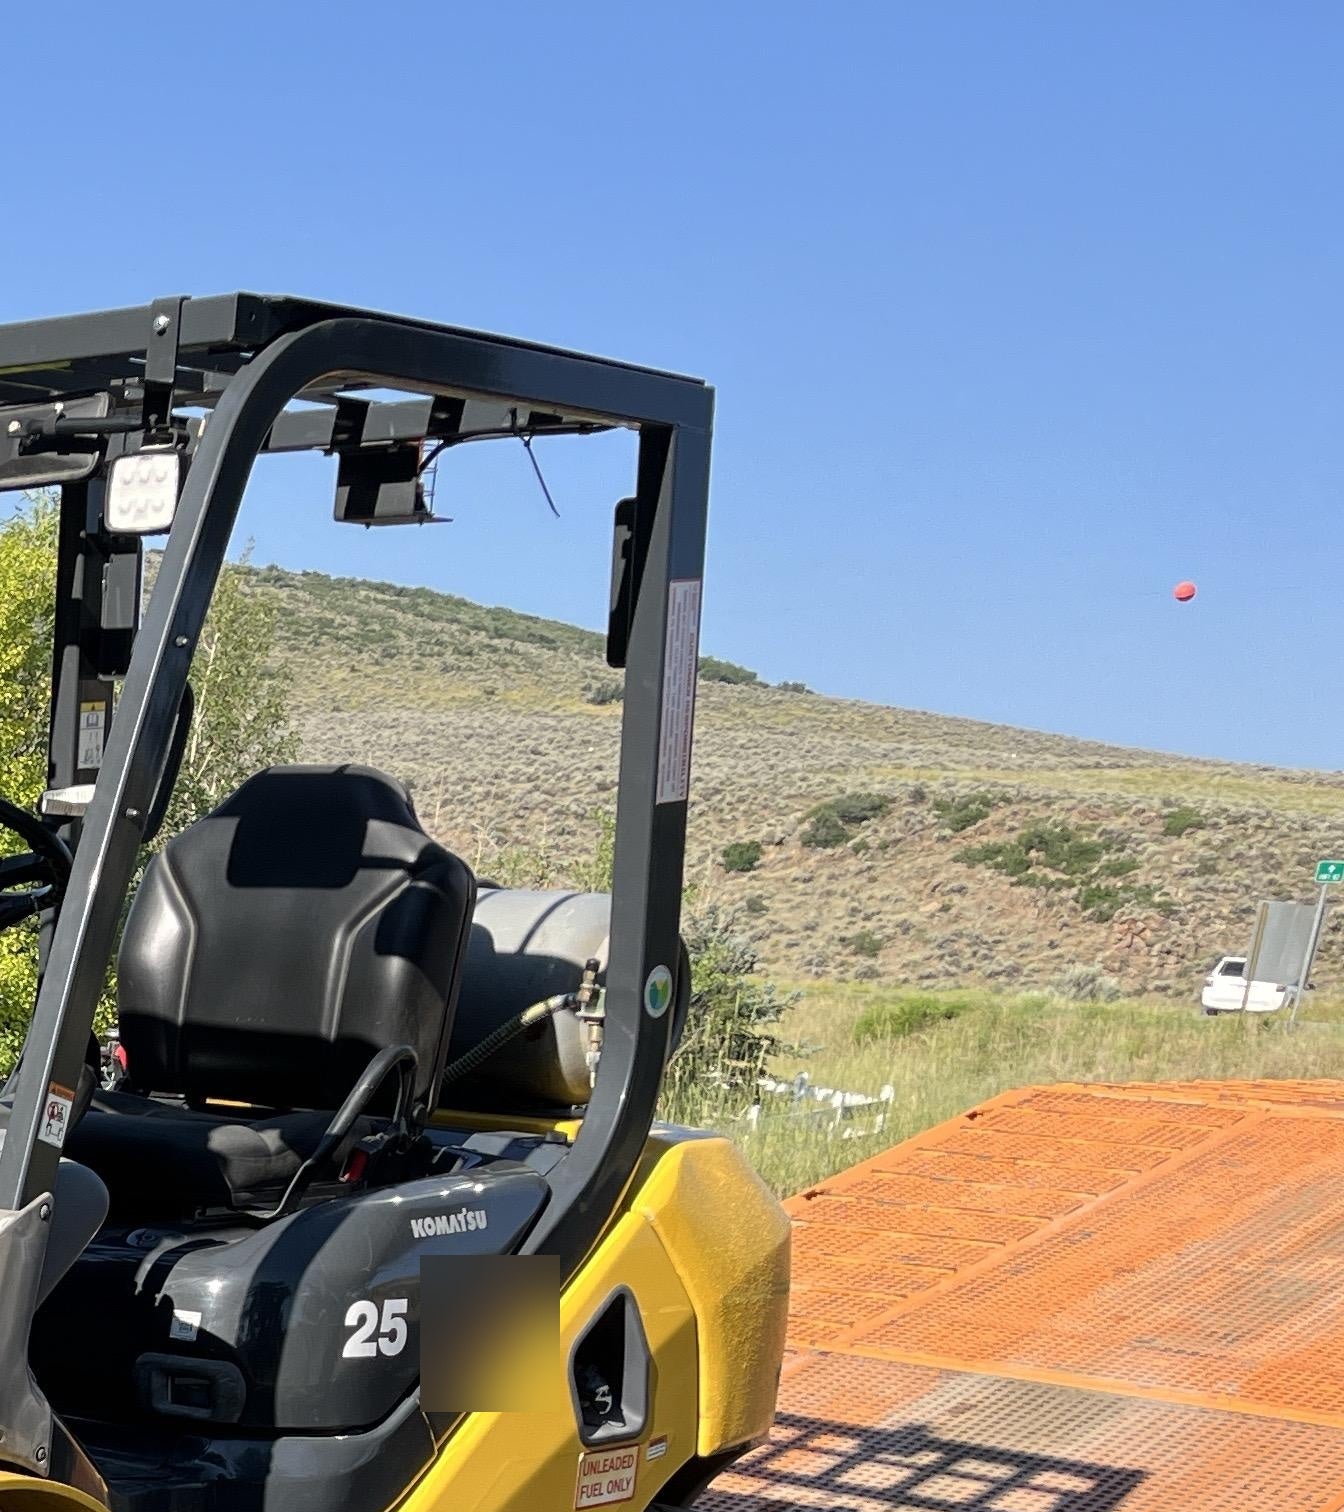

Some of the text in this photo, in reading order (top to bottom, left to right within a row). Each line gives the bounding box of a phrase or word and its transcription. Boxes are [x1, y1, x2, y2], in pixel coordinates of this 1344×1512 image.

[410, 1207, 488, 1239] KOMATSU
[342, 1298, 409, 1358] 25
[582, 1454, 634, 1476] UNLEADED
[580, 1477, 632, 1499] FUEL ONLY
